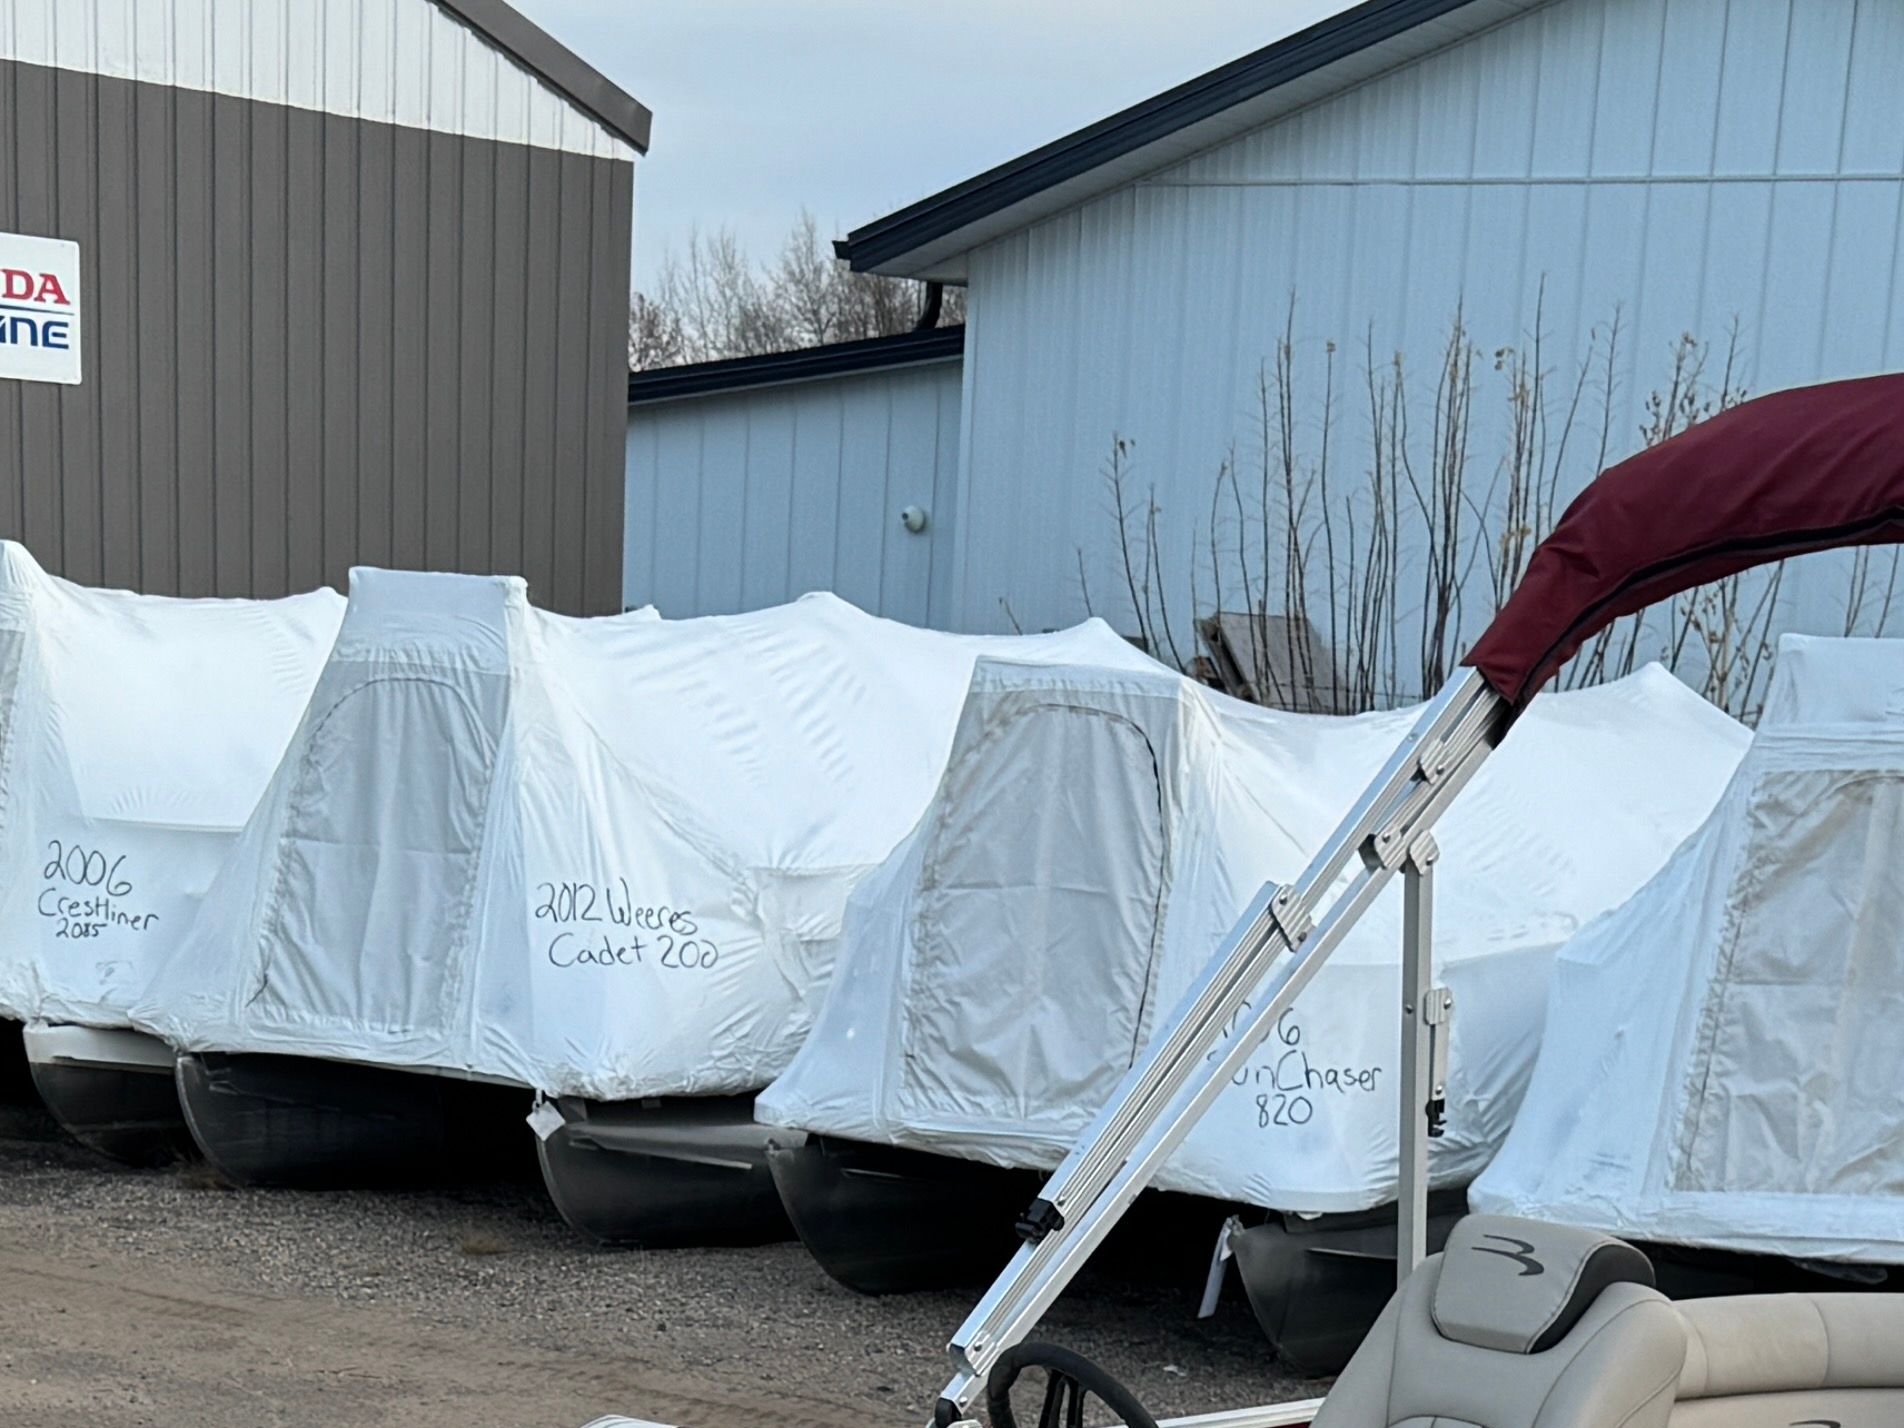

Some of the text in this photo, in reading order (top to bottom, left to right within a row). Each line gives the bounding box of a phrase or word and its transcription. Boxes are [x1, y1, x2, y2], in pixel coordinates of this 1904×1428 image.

[43, 839, 133, 897] 2006
[38, 887, 159, 931] Crestliner
[535, 876, 698, 936] 2012 Weeres
[548, 932, 719, 969] Cadet 200
[1256, 1093, 1313, 1128] 820
